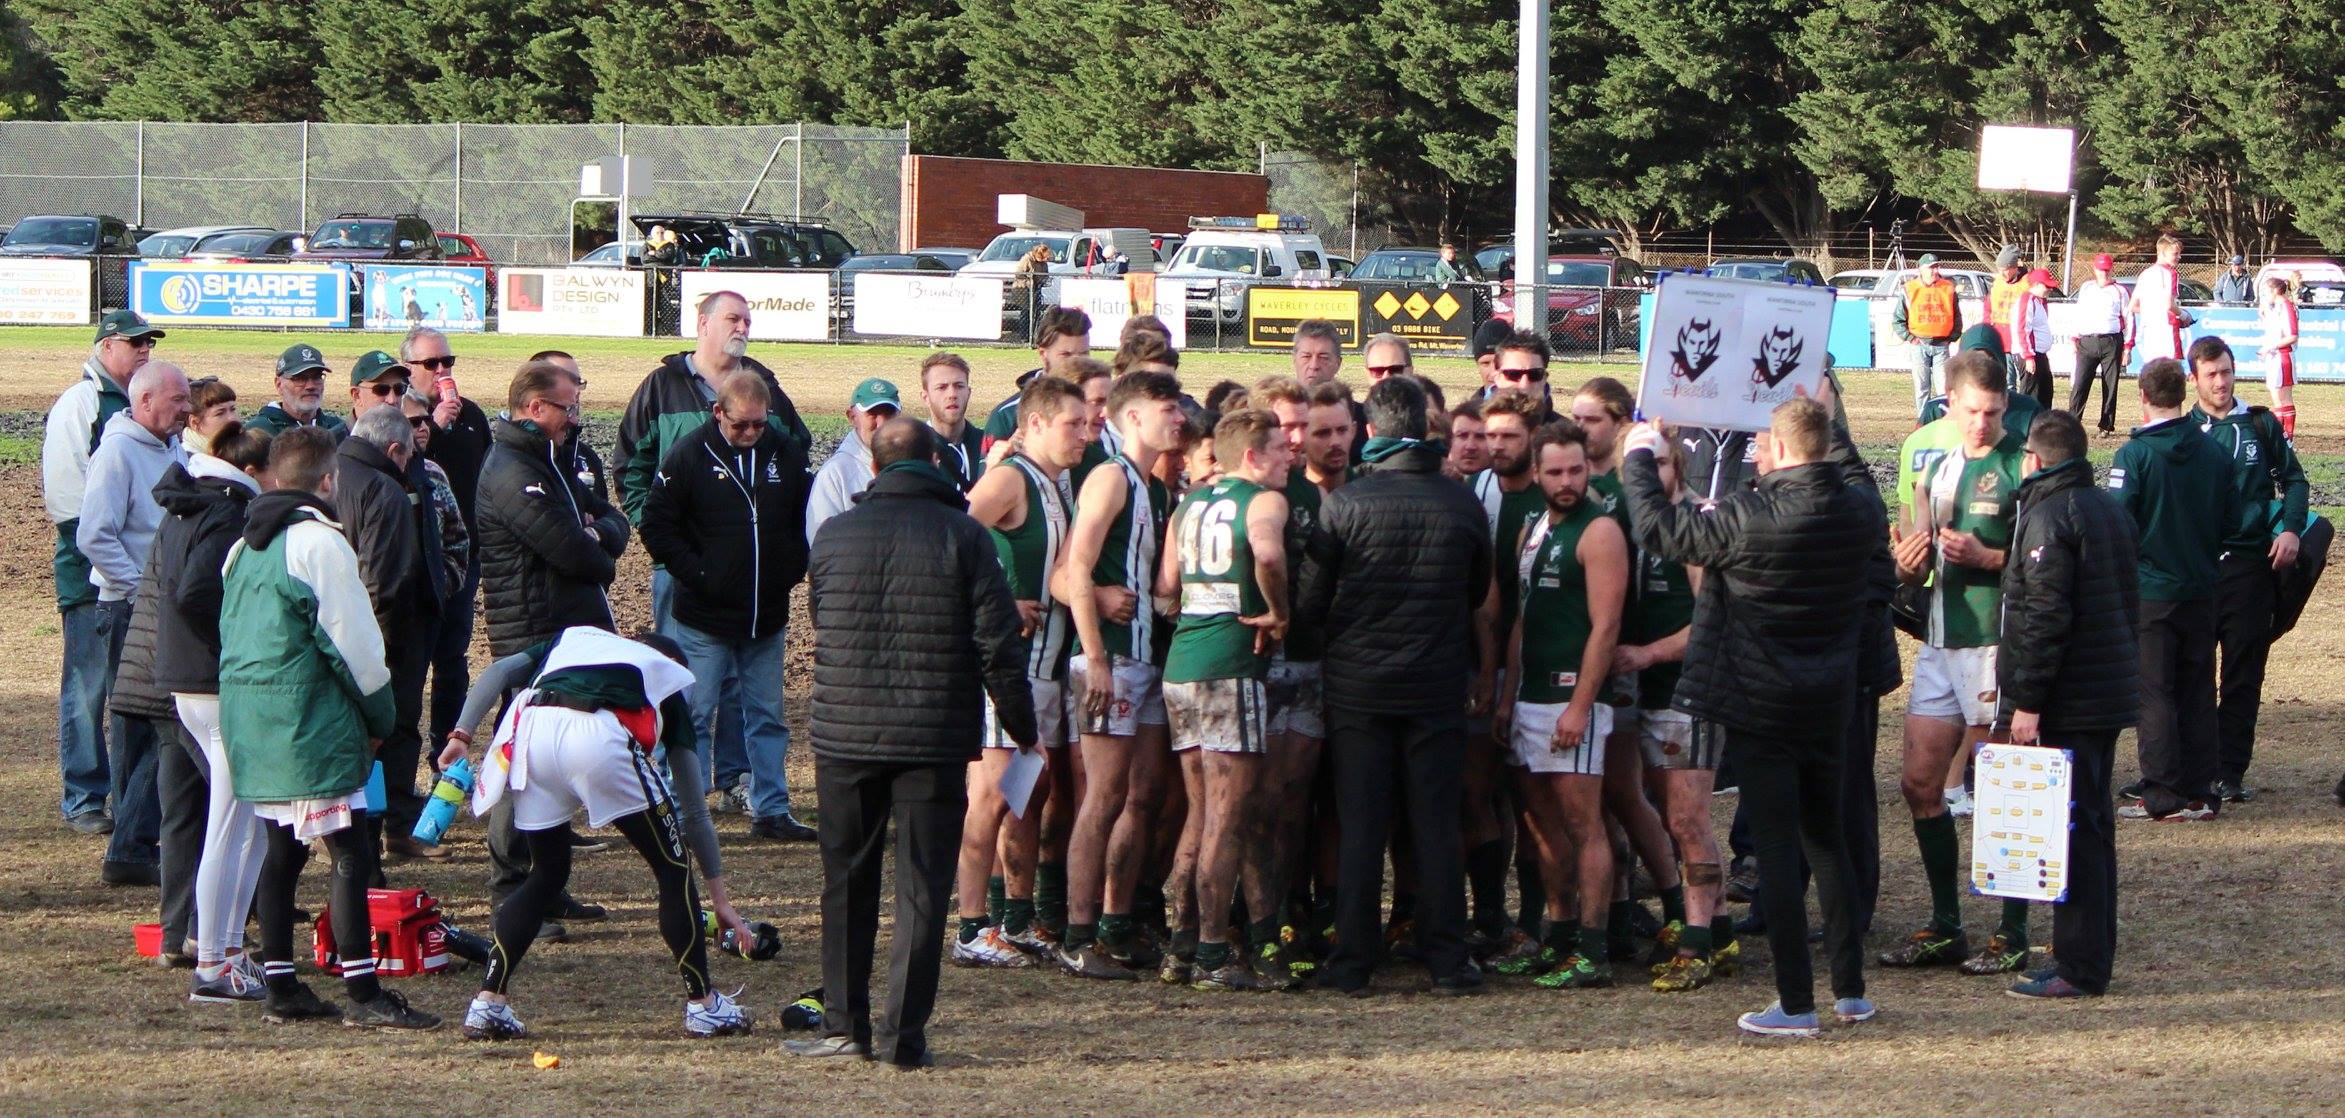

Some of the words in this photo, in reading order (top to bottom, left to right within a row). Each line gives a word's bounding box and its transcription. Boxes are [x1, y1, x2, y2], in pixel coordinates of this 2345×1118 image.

[203, 275, 317, 296] SHARPE
[553, 274, 634, 287] BALWYN
[553, 290, 620, 303] DESIGN
[747, 297, 816, 312] orMade
[1392, 325, 1401, 333] 03
[1177, 499, 1237, 576] 46
